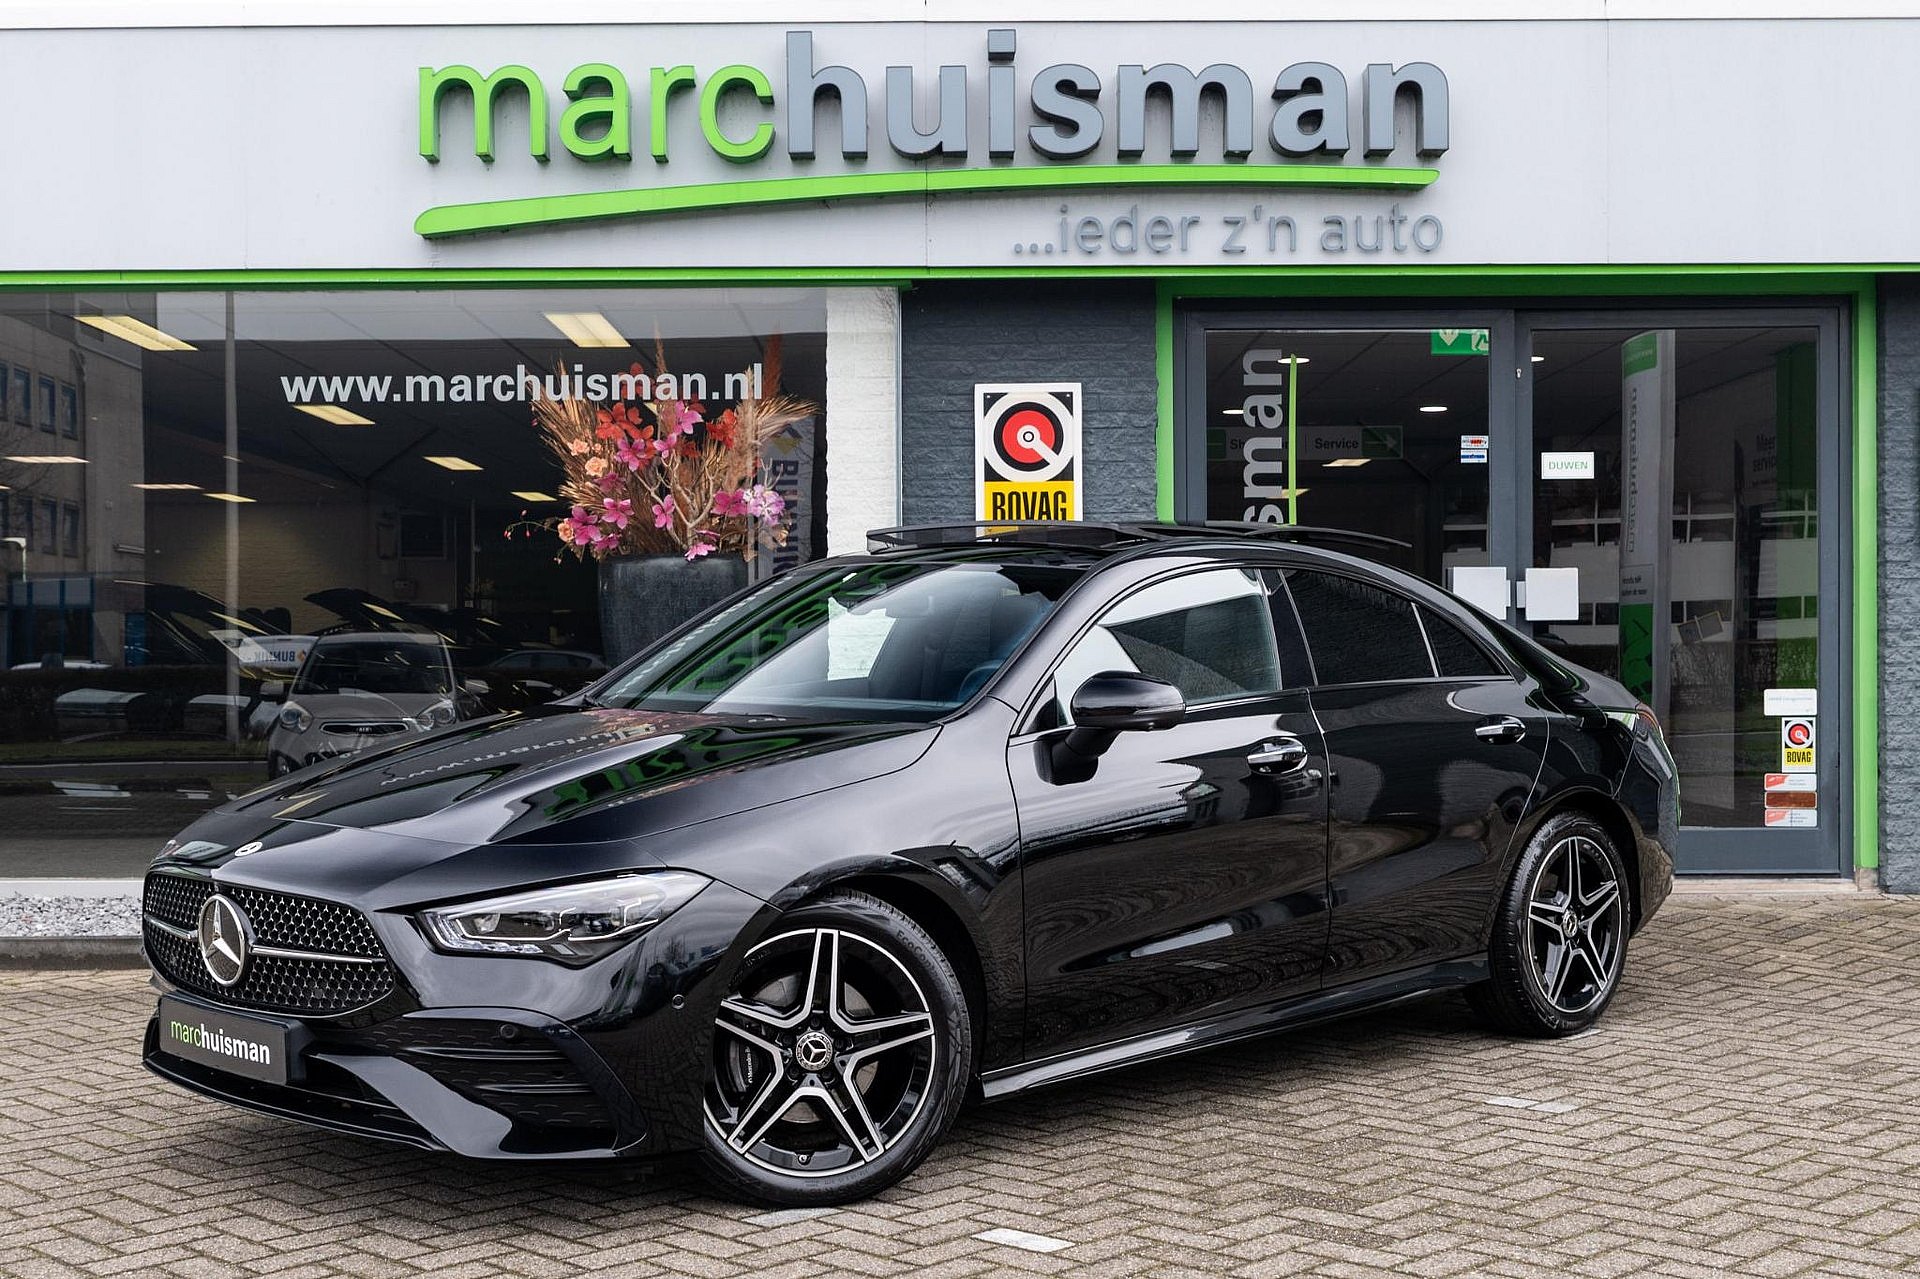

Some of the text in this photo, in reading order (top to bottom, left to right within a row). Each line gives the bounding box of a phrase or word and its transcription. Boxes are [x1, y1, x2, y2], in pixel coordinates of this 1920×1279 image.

[418, 30, 1450, 165] marchuisman
[1222, 205, 1297, 253] z'n
[1320, 205, 1443, 253] auto
[281, 363, 764, 401] www.marchuisman.nl
[1315, 438, 1359, 450] Service
[1549, 461, 1588, 470] DUWEN
[992, 491, 1067, 521] BOVAG
[1786, 752, 1811, 763] BOVAG
[170, 1020, 270, 1065] marchuisman
